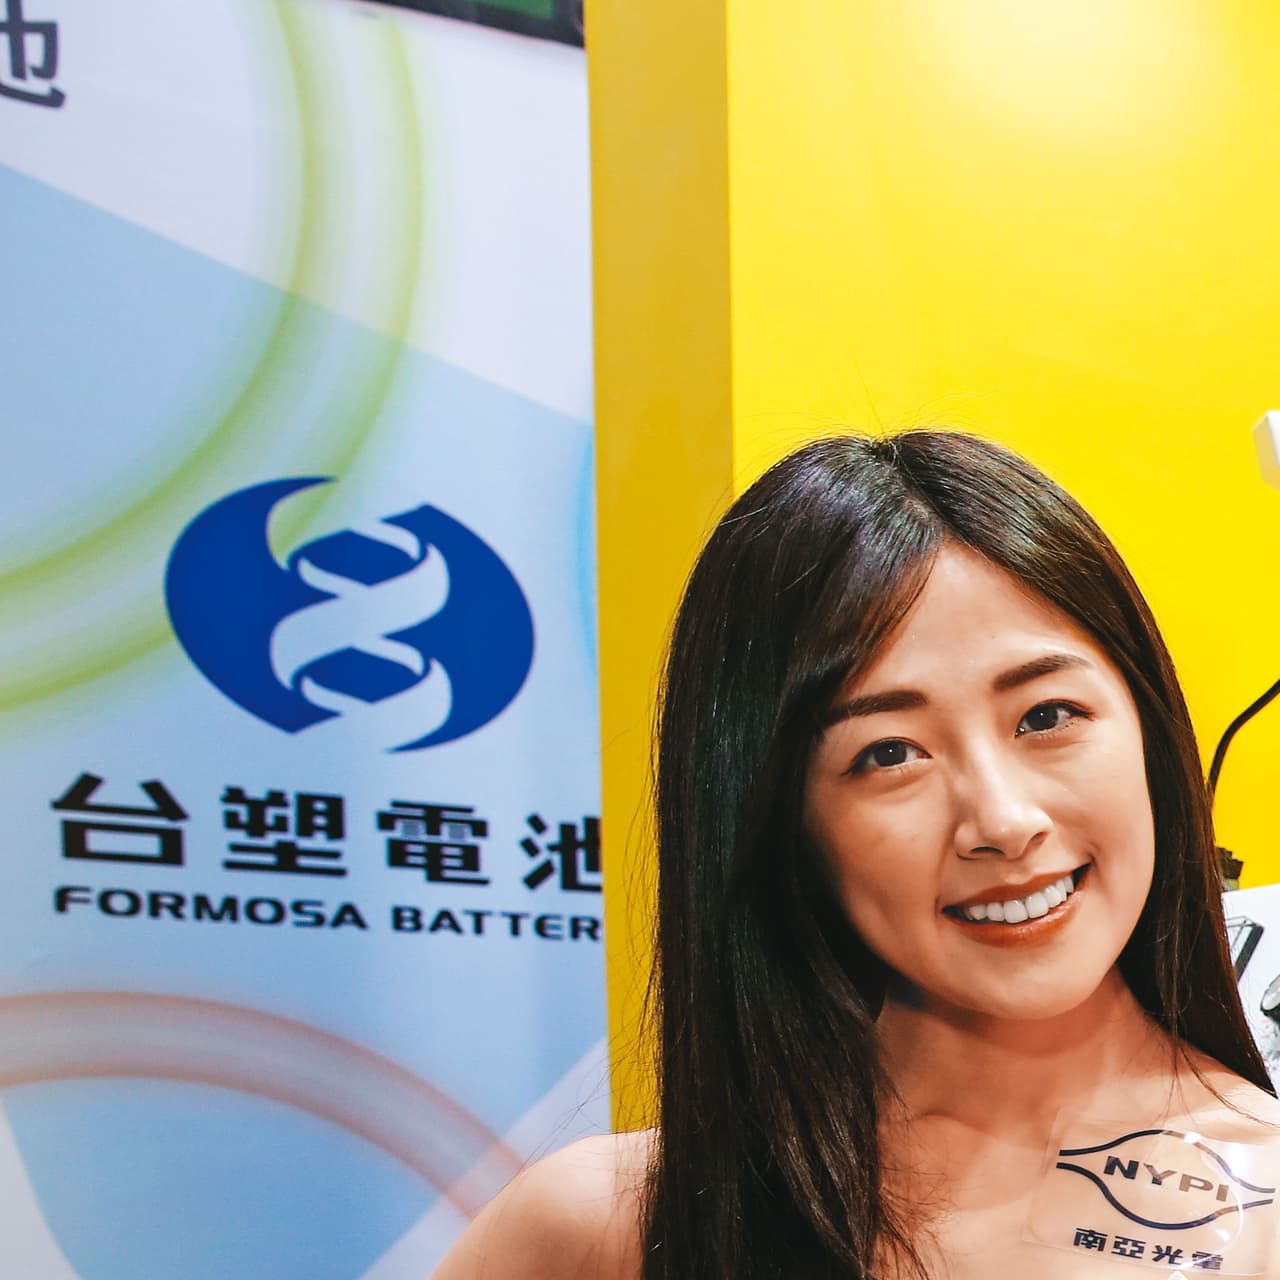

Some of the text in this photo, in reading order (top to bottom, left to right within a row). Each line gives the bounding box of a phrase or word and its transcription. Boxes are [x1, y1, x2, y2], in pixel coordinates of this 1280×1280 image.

[50, 772, 602, 893] 台塑電池
[55, 885, 601, 945] FORMOSA BATTER
[1103, 1155, 1231, 1203] NYPI
